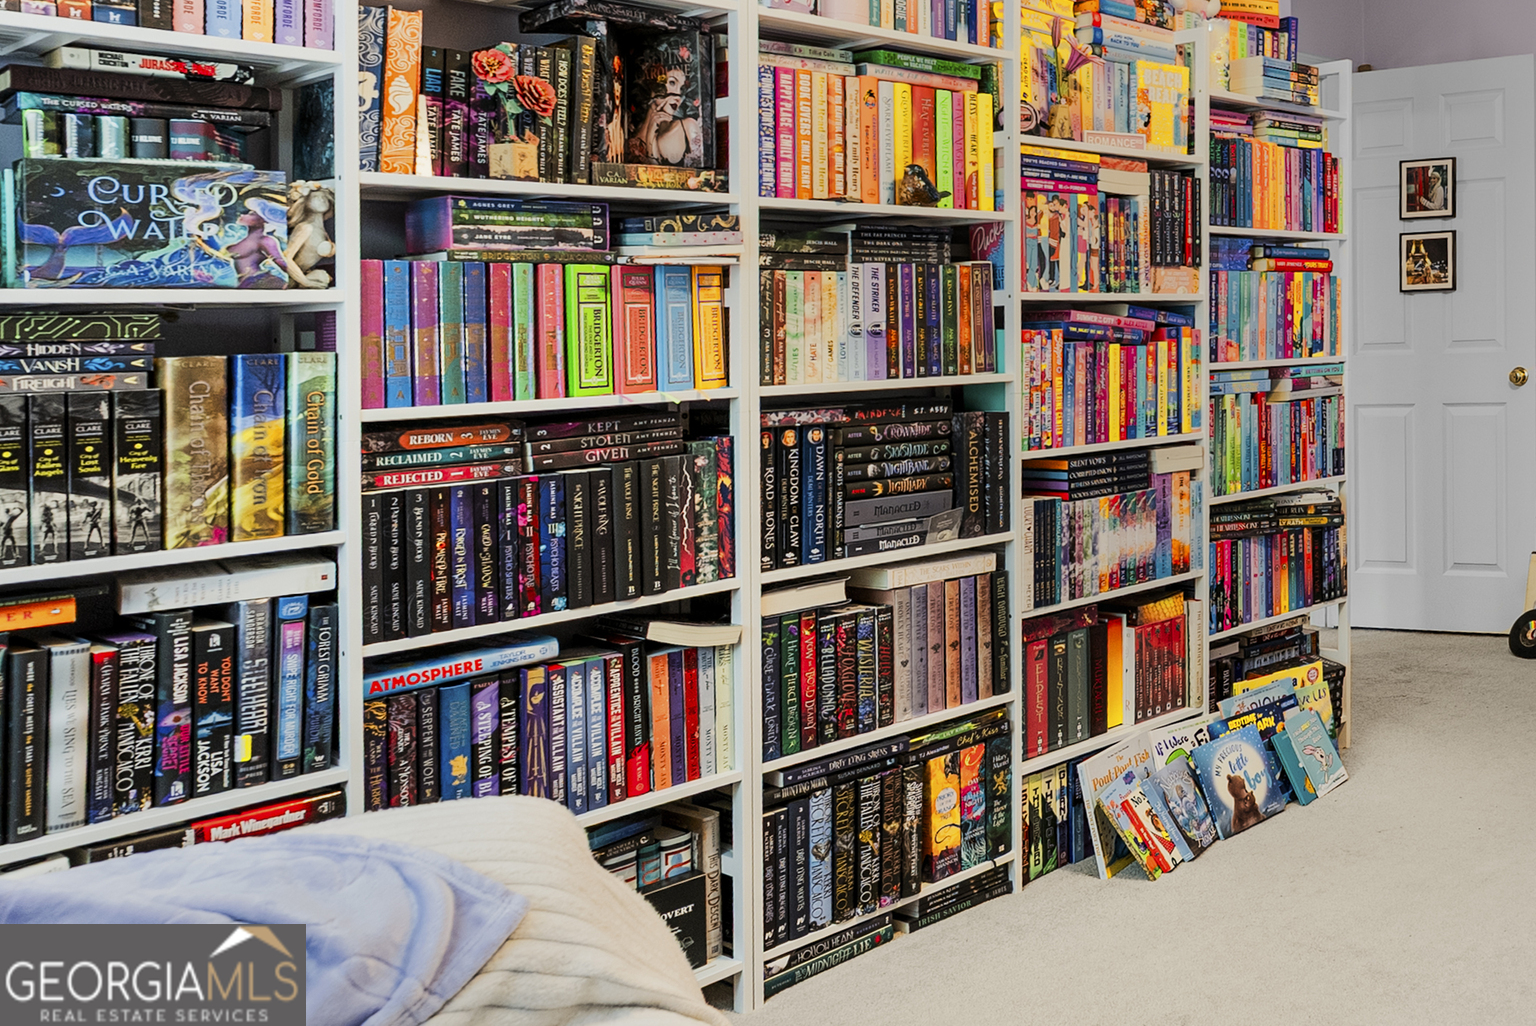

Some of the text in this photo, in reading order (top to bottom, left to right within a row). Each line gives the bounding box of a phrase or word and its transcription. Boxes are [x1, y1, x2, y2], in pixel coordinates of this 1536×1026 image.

[425, 68, 442, 92] LIAR
[449, 69, 466, 97] FAKE
[1143, 69, 1183, 87] BEACH
[41, 97, 133, 112] THE CURSED WATERS
[1150, 87, 1179, 104] READ
[210, 114, 242, 122] VARIAN
[780, 74, 793, 188] HAPPY PLACE EMILY HENRY
[799, 74, 811, 189] BOOK LOVERS EMILY HENRY
[449, 109, 461, 162] TATE JAMES
[475, 112, 487, 164] TATE JAMES
[1087, 136, 1136, 148] ROMANCE
[87, 175, 238, 215] CURSED
[78, 210, 250, 240] WATERS
[473, 214, 516, 223] WUTHERING
[851, 266, 860, 320] THE DEFENDER
[870, 266, 880, 313] THE STRIKER
[26, 343, 82, 356] HIDDEN
[593, 309, 603, 377] BRIDGERTON
[638, 309, 647, 375] BRIDGERTON
[20, 358, 80, 373] VANISH
[12, 376, 76, 391] FIRELIGHT
[75, 425, 103, 434] CLARE
[125, 422, 151, 430] CLARE
[253, 390, 274, 439] Chain
[588, 421, 622, 433] KEPT
[34, 427, 63, 436] CLARE
[306, 391, 325, 495] Chain of Gold
[409, 433, 453, 446] REBORN
[580, 433, 631, 448] STOLEN
[375, 451, 443, 467] RECLAIMED
[585, 448, 630, 462] GIVEN
[881, 459, 930, 477] NIGHTBANE
[383, 470, 443, 485] REJECTED
[969, 431, 979, 513] ALCHEMISED
[764, 467, 775, 550] ROAD BONES
[788, 448, 799, 548] KINGDOM CLAW
[814, 445, 824, 545] DAWN NORTH
[874, 501, 921, 516] MANACLED
[879, 535, 920, 550] MANACLED
[173, 635, 189, 704] LISA JACKSON
[316, 627, 332, 704] FOREST GRIMM
[368, 658, 484, 695] ATMOSPHERE
[631, 647, 640, 677] BLOOD
[858, 637, 875, 700] WISTERIA
[198, 662, 208, 704] TO KNOW
[210, 669, 219, 693] WANT
[221, 656, 231, 703] YOU DON'T
[820, 645, 836, 720] BELLADONNA
[1035, 663, 1044, 723] ELDEST
[1056, 658, 1064, 720] BRISINGR
[552, 679, 564, 772] ASSISTANT VILLAIN
[610, 668, 622, 757] APPRENTICE VILLAIN
[284, 725, 297, 755] MURDER
[422, 706, 434, 788] SERPENT WOLF
[1216, 744, 1243, 766] PRECIOUS
[196, 740, 210, 793] JACKSON
[211, 751, 223, 777] LISA
[1133, 748, 1150, 768] Fish
[1228, 753, 1248, 774] little
[1245, 767, 1272, 791] boy
[210, 808, 306, 842] Mark Winegardner
[918, 900, 972, 928] IRISH SAVIOR
[853, 938, 872, 956] LIE
